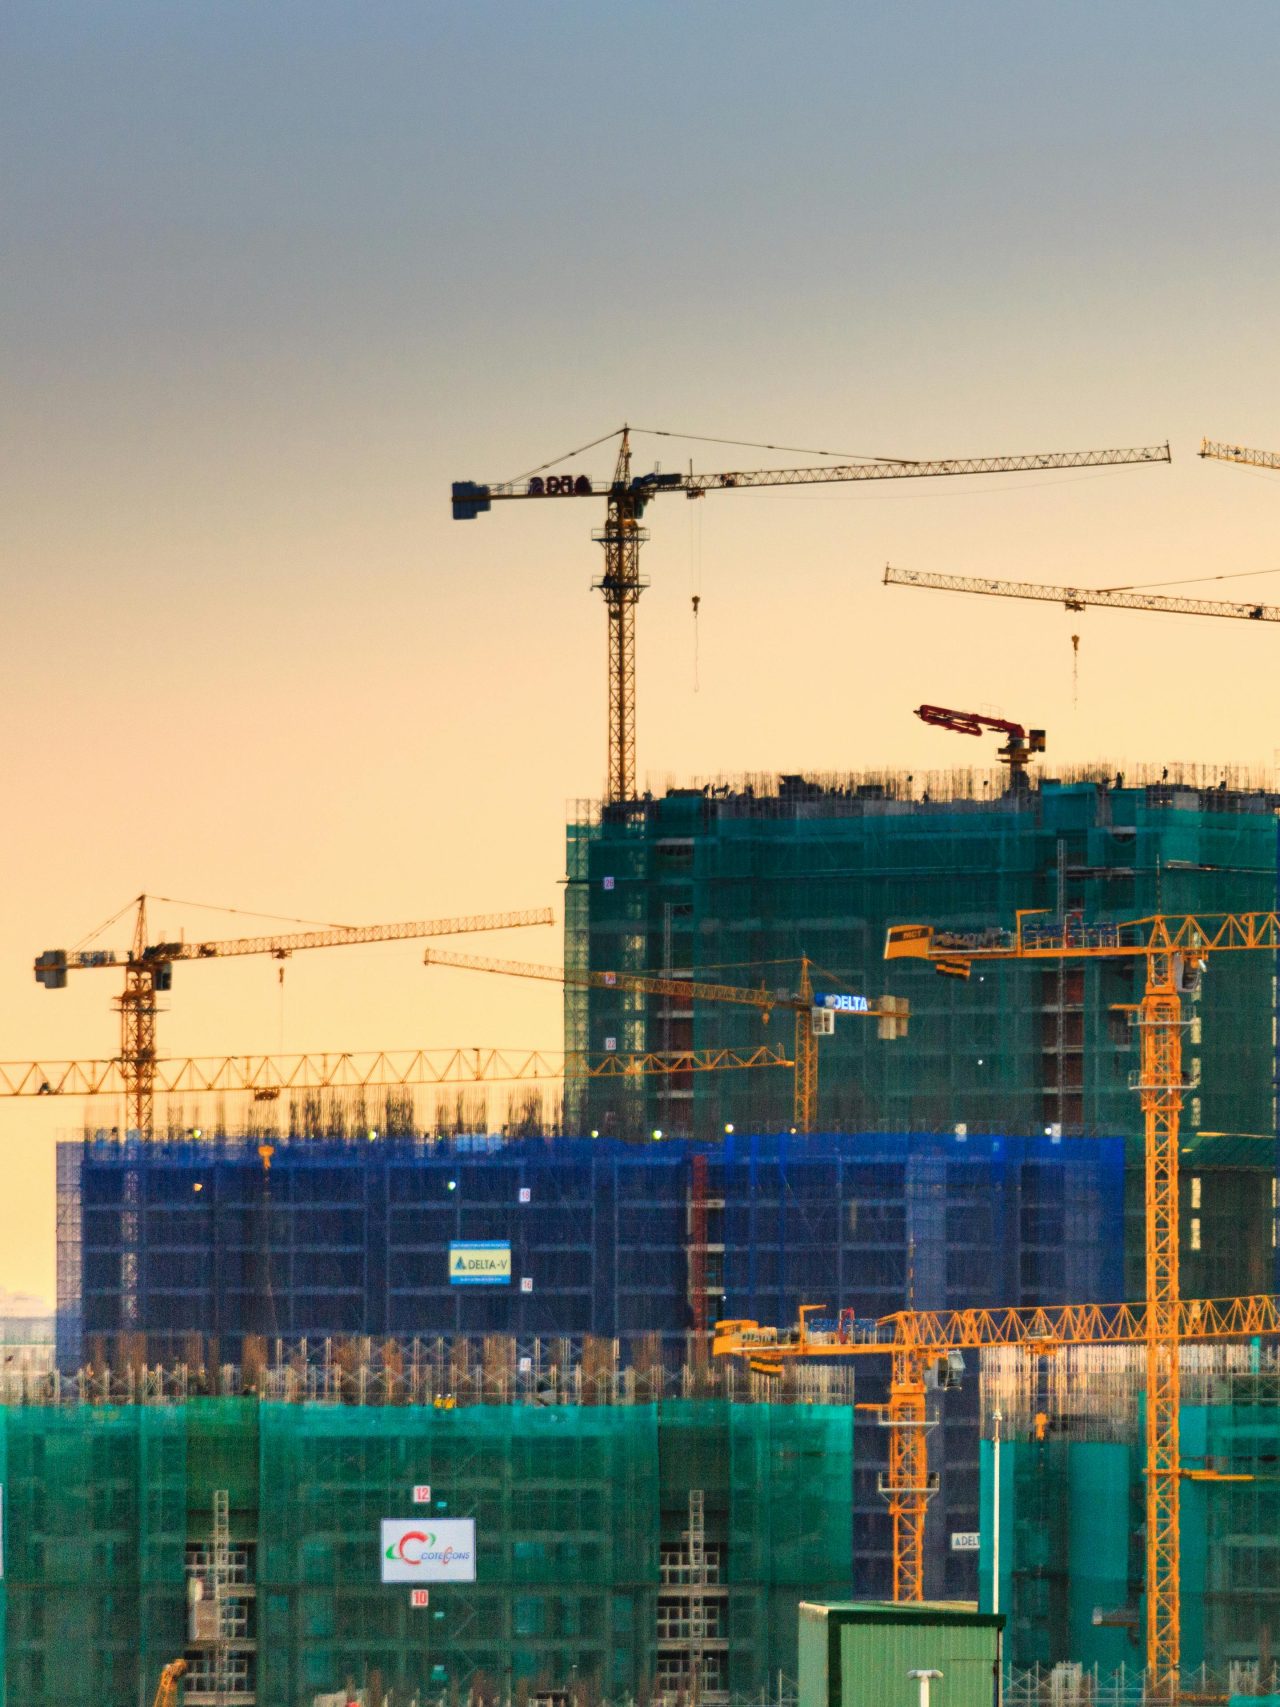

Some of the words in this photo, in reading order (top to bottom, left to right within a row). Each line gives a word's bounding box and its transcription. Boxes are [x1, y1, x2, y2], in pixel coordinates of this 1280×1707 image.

[834, 994, 868, 1011] DELTA
[416, 1487, 428, 1500] 12
[414, 1591, 426, 1604] 10
